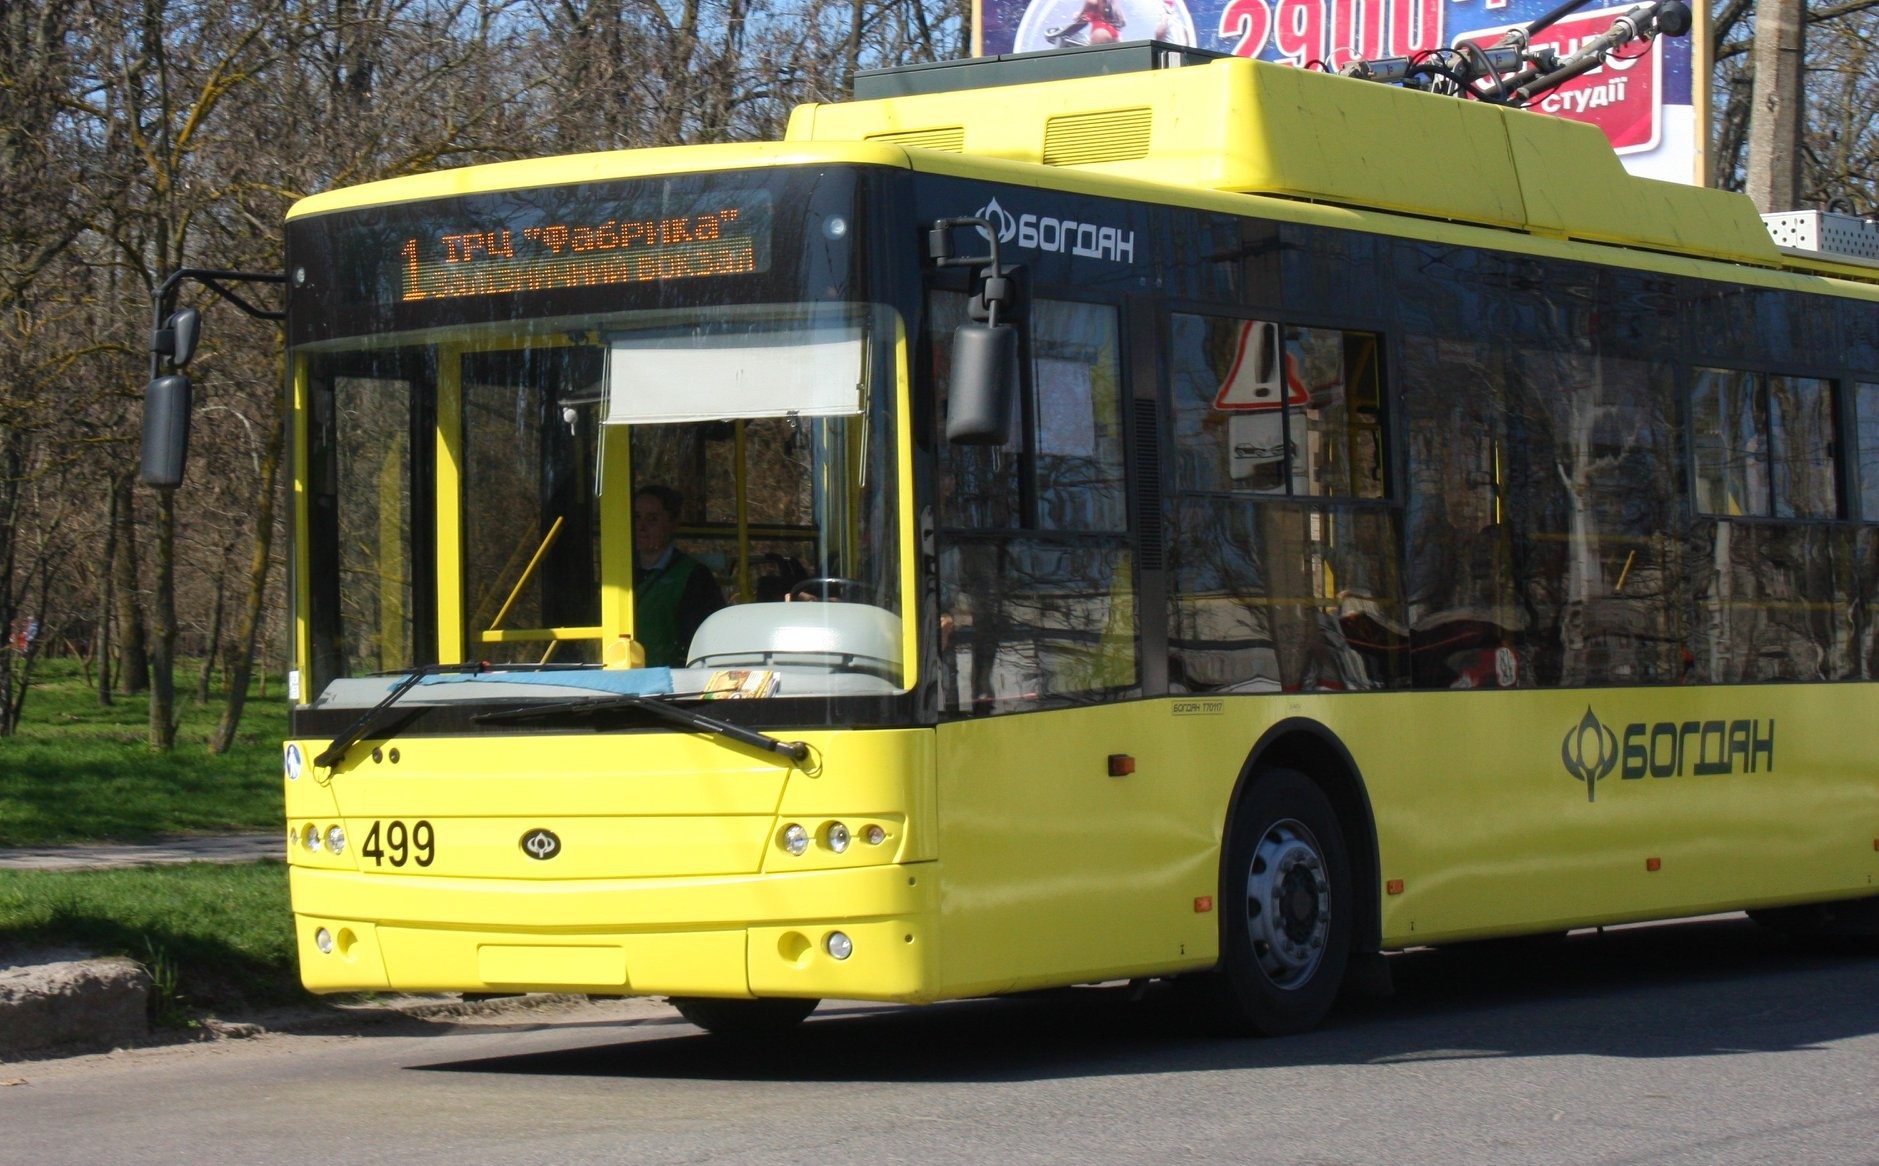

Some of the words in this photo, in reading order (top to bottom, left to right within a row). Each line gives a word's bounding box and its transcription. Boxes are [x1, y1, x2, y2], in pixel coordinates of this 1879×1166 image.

[442, 230, 514, 263] ТРЦ
[1018, 213, 1135, 264] БОГДАН
[401, 238, 428, 301] 1
[1173, 703, 1200, 713] БОГДАН
[1621, 718, 1775, 780] БОГДАН
[362, 820, 435, 867] 499
